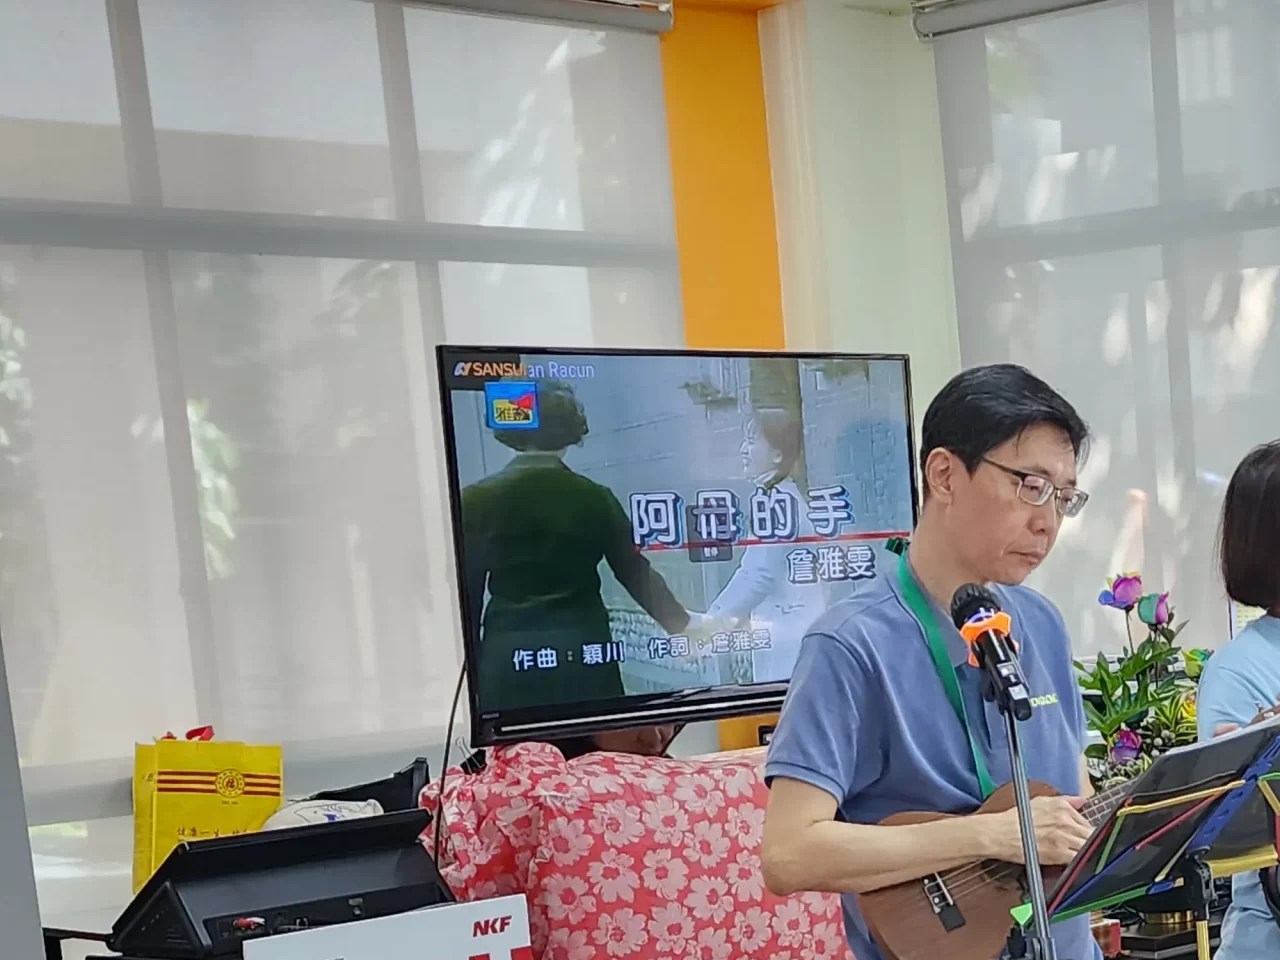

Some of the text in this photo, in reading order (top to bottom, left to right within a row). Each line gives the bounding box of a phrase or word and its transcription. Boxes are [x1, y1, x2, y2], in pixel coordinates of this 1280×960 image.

[548, 361, 595, 378] Racun
[629, 486, 852, 546] 阿母的手
[787, 546, 876, 583] 詹雅雯
[472, 915, 512, 937] NKF
